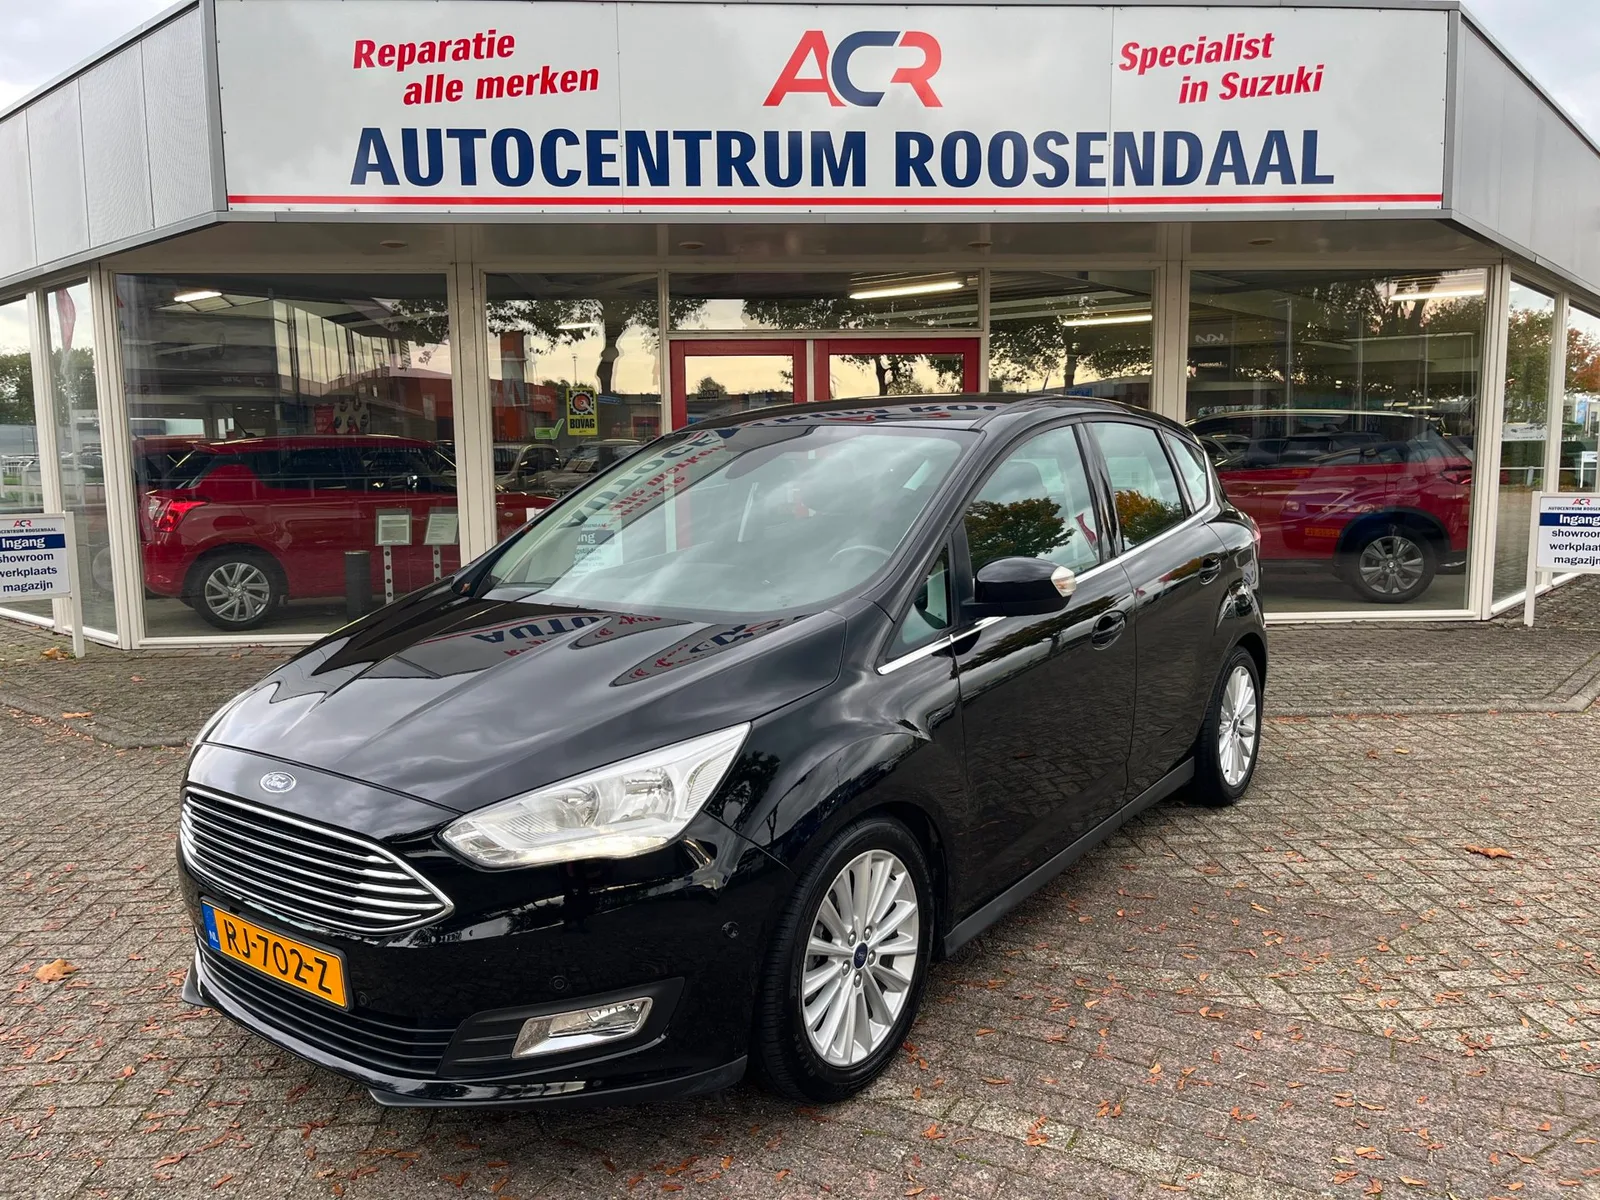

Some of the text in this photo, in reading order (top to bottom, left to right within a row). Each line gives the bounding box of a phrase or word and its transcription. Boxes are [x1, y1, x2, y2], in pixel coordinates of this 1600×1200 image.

[353, 29, 516, 72] Reparatie
[1119, 32, 1275, 76] Specialist
[763, 30, 943, 107] ACR
[402, 66, 600, 106] alle merken
[1178, 63, 1325, 104] in Suzuki
[350, 127, 1334, 188] AUTOCENTRUM ROOSENDAAL
[569, 418, 595, 430] BOVAG
[1572, 498, 1591, 506] ACR
[13, 519, 32, 528] ACR
[1559, 514, 1600, 527] Ingang
[2, 537, 46, 550] Ingang
[1553, 556, 1600, 567] magazijn
[3, 580, 53, 593] magazijn
[209, 929, 219, 943] NL
[223, 918, 333, 996] RJ-702-Z
